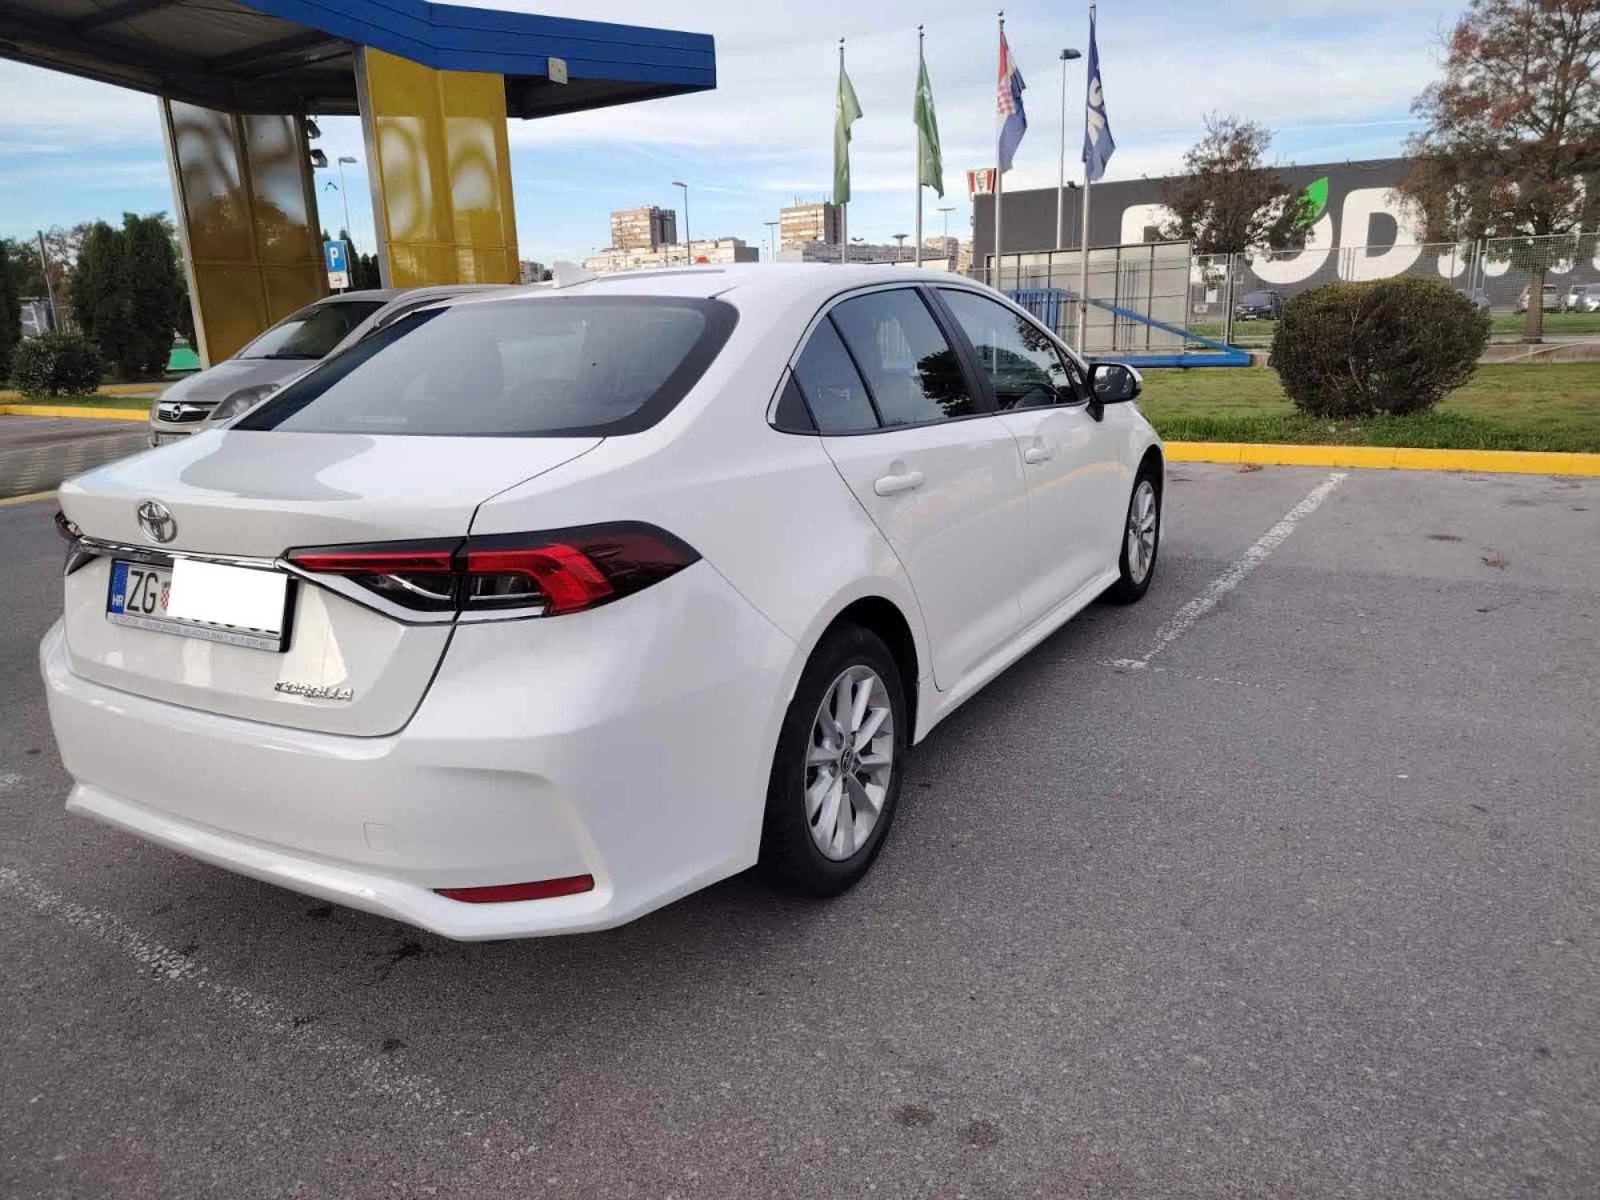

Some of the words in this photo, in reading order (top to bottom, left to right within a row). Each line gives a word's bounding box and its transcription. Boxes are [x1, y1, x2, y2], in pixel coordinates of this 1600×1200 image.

[329, 247, 338, 267] P
[112, 593, 124, 607] HR
[127, 571, 158, 613] ZG
